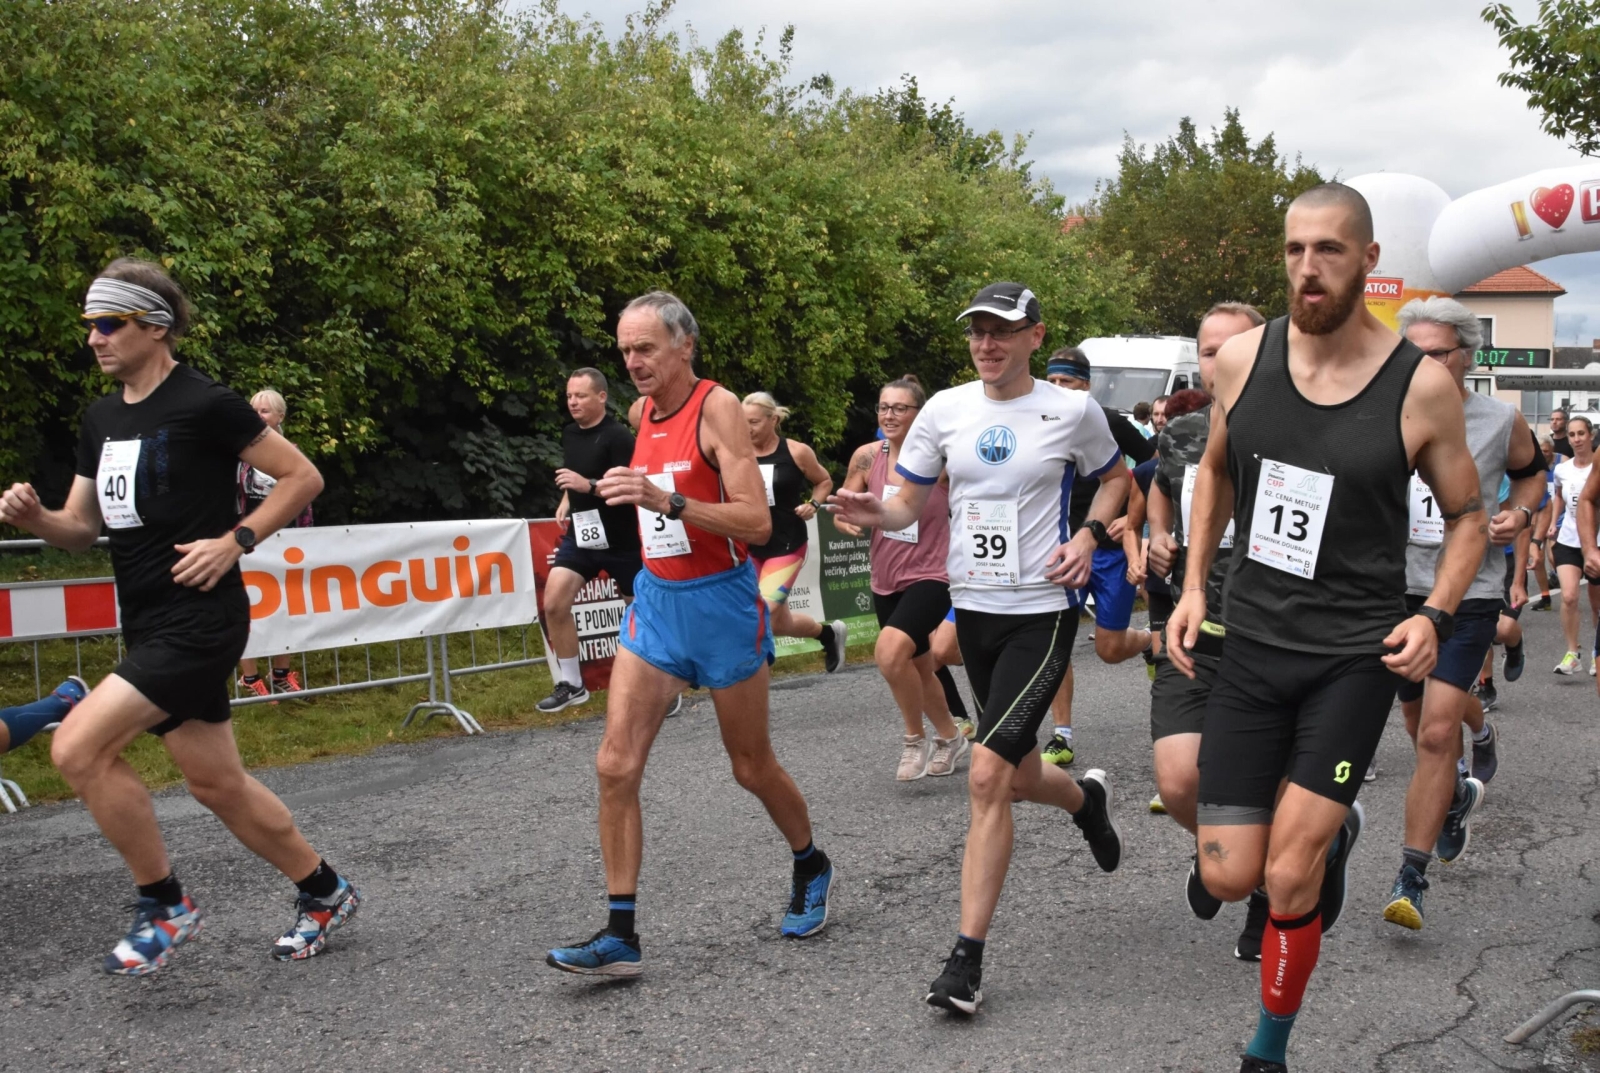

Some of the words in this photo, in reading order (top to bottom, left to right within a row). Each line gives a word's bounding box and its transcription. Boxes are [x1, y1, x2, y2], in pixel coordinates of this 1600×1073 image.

[104, 474, 127, 501] 40
[1264, 489, 1274, 498] 62.
[1275, 492, 1293, 503] CENA
[1294, 498, 1320, 511] METUJE
[581, 526, 600, 542] 88
[1269, 504, 1310, 542] 13
[828, 539, 855, 550] Kavárna,
[972, 533, 1007, 560] 39
[1255, 532, 1280, 546] DOMINIK
[1281, 541, 1313, 556] DOUBRAVA
[824, 552, 848, 564] hudební
[840, 580, 849, 590] do
